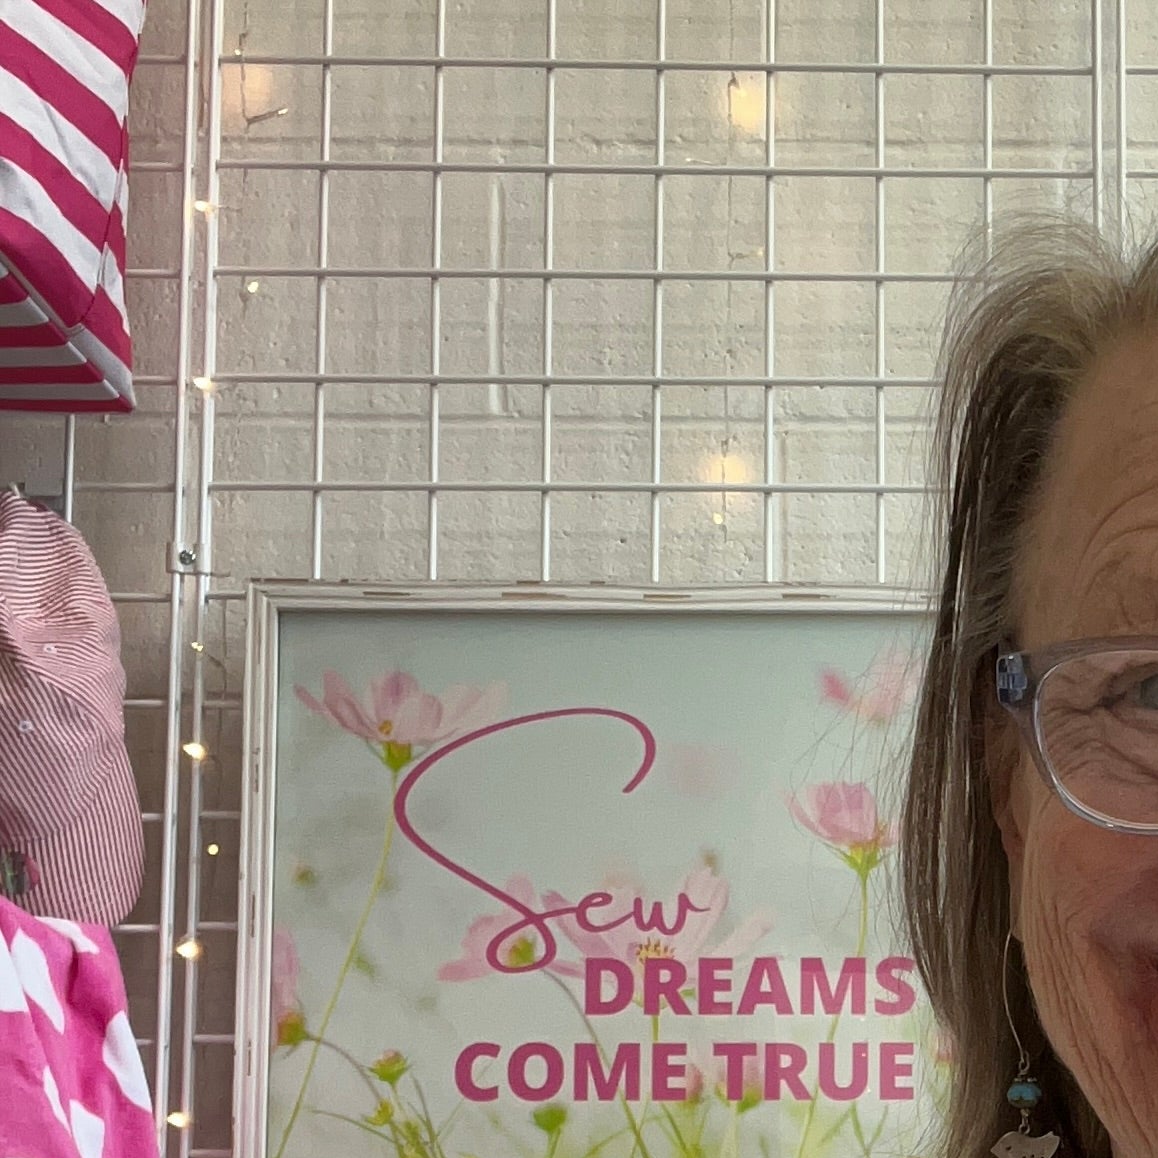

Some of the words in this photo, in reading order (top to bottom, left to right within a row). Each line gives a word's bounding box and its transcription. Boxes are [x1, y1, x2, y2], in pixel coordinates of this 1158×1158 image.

[393, 707, 711, 974] Sew
[583, 956, 917, 1016] DREAMS
[454, 1041, 688, 1102] COME
[712, 1042, 914, 1101] TRUE
